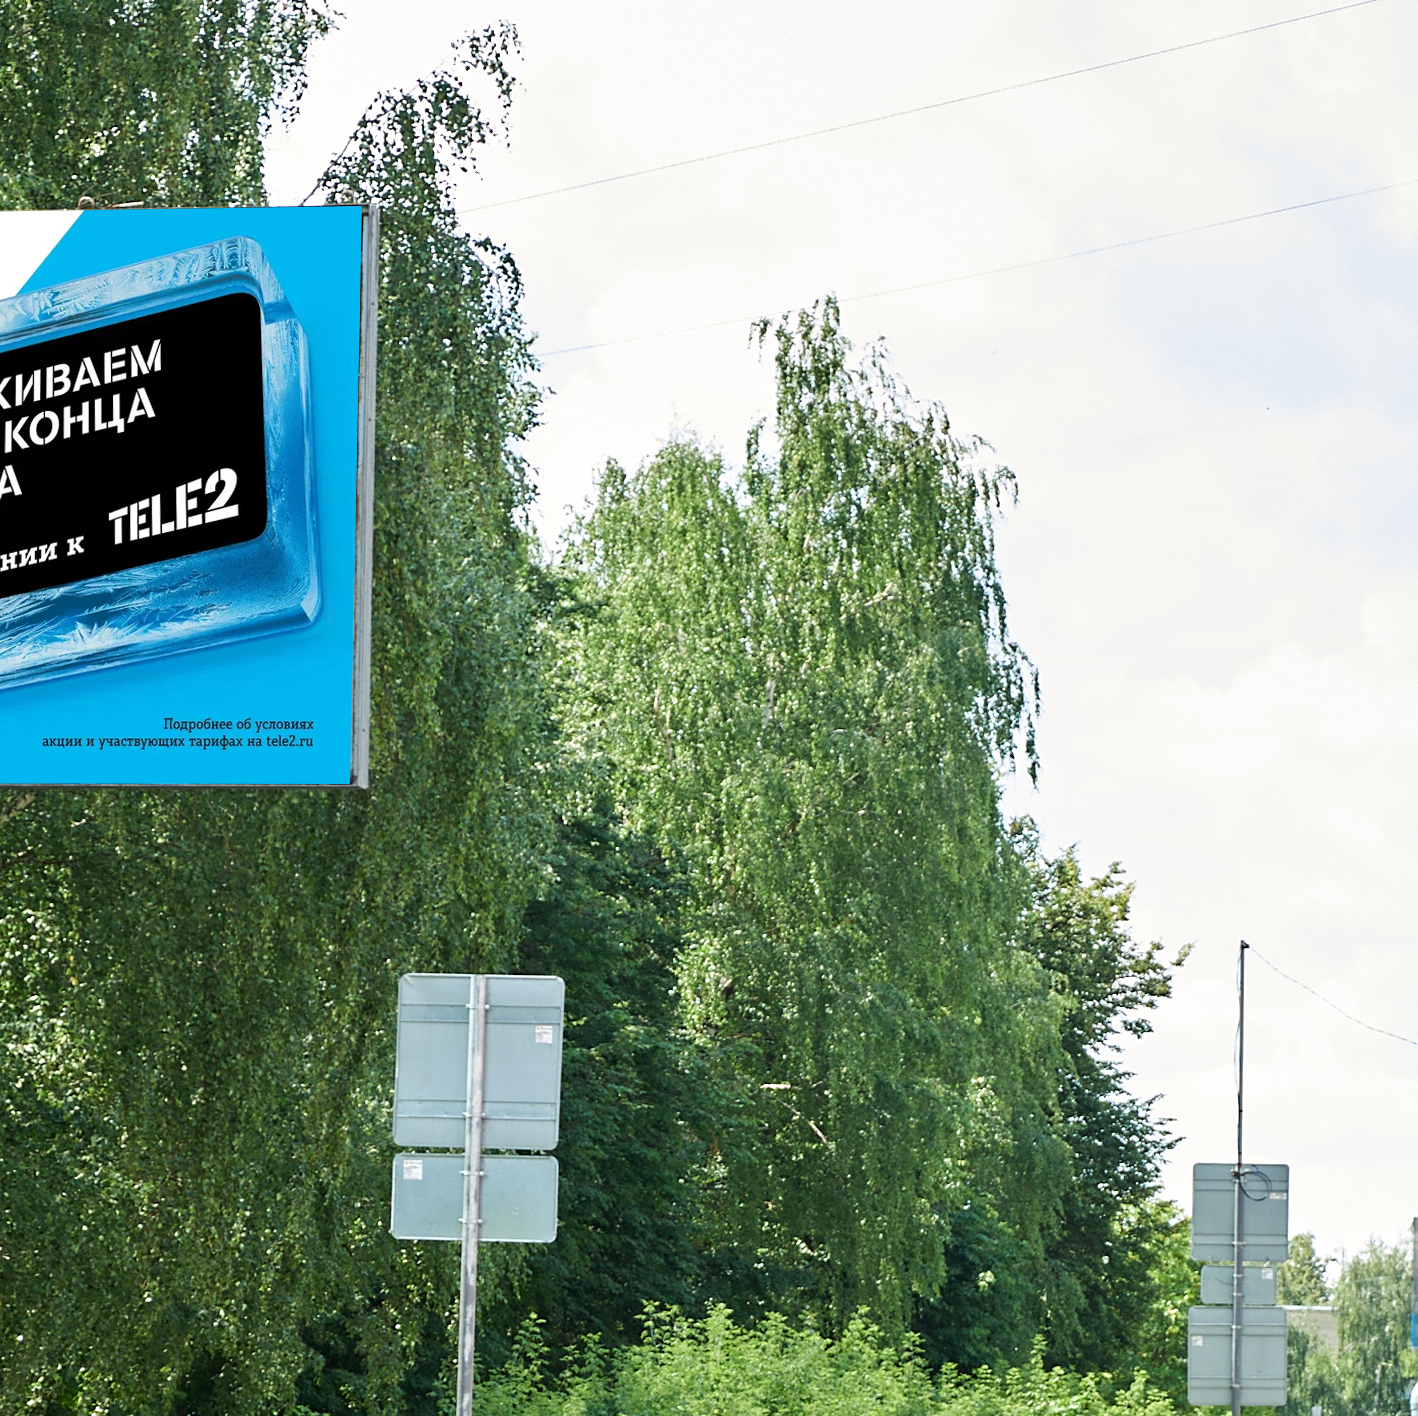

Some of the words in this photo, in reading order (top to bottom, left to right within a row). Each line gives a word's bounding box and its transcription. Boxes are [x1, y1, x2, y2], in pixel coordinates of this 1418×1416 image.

[3, 387, 156, 454] КОНЦА
[108, 467, 239, 545] TELE2
[66, 535, 85, 555] к
[163, 717, 233, 733] Подробнее
[236, 717, 252, 730] об
[255, 720, 314, 733] условиях
[42, 736, 82, 749] акции
[86, 737, 95, 747] и
[98, 736, 185, 750] участвующих
[188, 735, 243, 750] тарифах
[246, 737, 263, 747] на
[266, 735, 314, 747] tele2.ru
